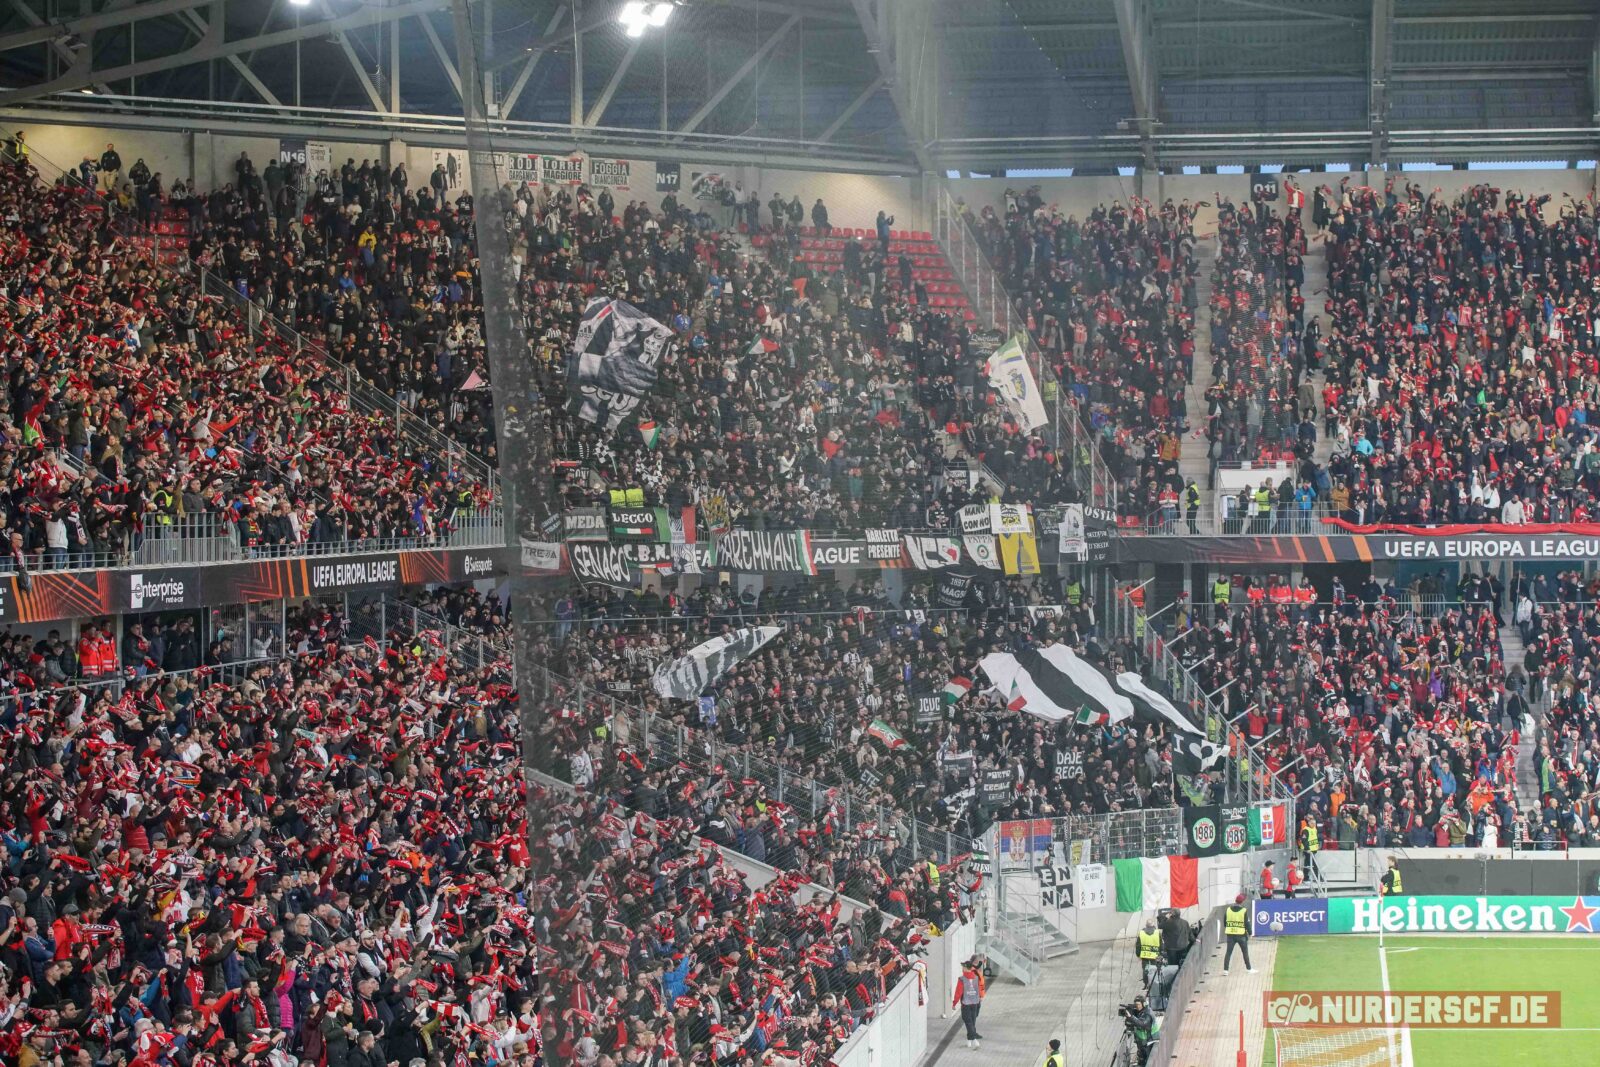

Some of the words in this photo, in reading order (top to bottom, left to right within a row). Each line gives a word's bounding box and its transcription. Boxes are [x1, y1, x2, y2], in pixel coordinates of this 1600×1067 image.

[281, 151, 306, 164] N16
[509, 157, 538, 170] RODI
[544, 160, 581, 172] TORRE
[594, 162, 628, 175] FOGGIA
[543, 169, 582, 181] MAGGIORE
[656, 173, 678, 185] N17
[566, 515, 606, 529] MEDA
[814, 547, 860, 564] AGUE
[867, 544, 902, 559] PRESENTE
[1384, 541, 1440, 557] UEFA
[1444, 540, 1526, 557] EUROPA
[1530, 540, 1600, 556] LEAGU
[469, 557, 493, 576] Swissquote
[574, 544, 631, 583] SENAGO
[313, 565, 336, 588] UEFA
[336, 561, 367, 587] EUROPA
[367, 557, 397, 583] LEAGUE
[135, 577, 184, 601] enterprise
[1056, 751, 1083, 765] DAJE
[1194, 825, 1214, 840] 1988
[1226, 828, 1246, 844] 1988
[1273, 909, 1326, 924] RESPECT
[1351, 897, 1556, 932] Heineken
